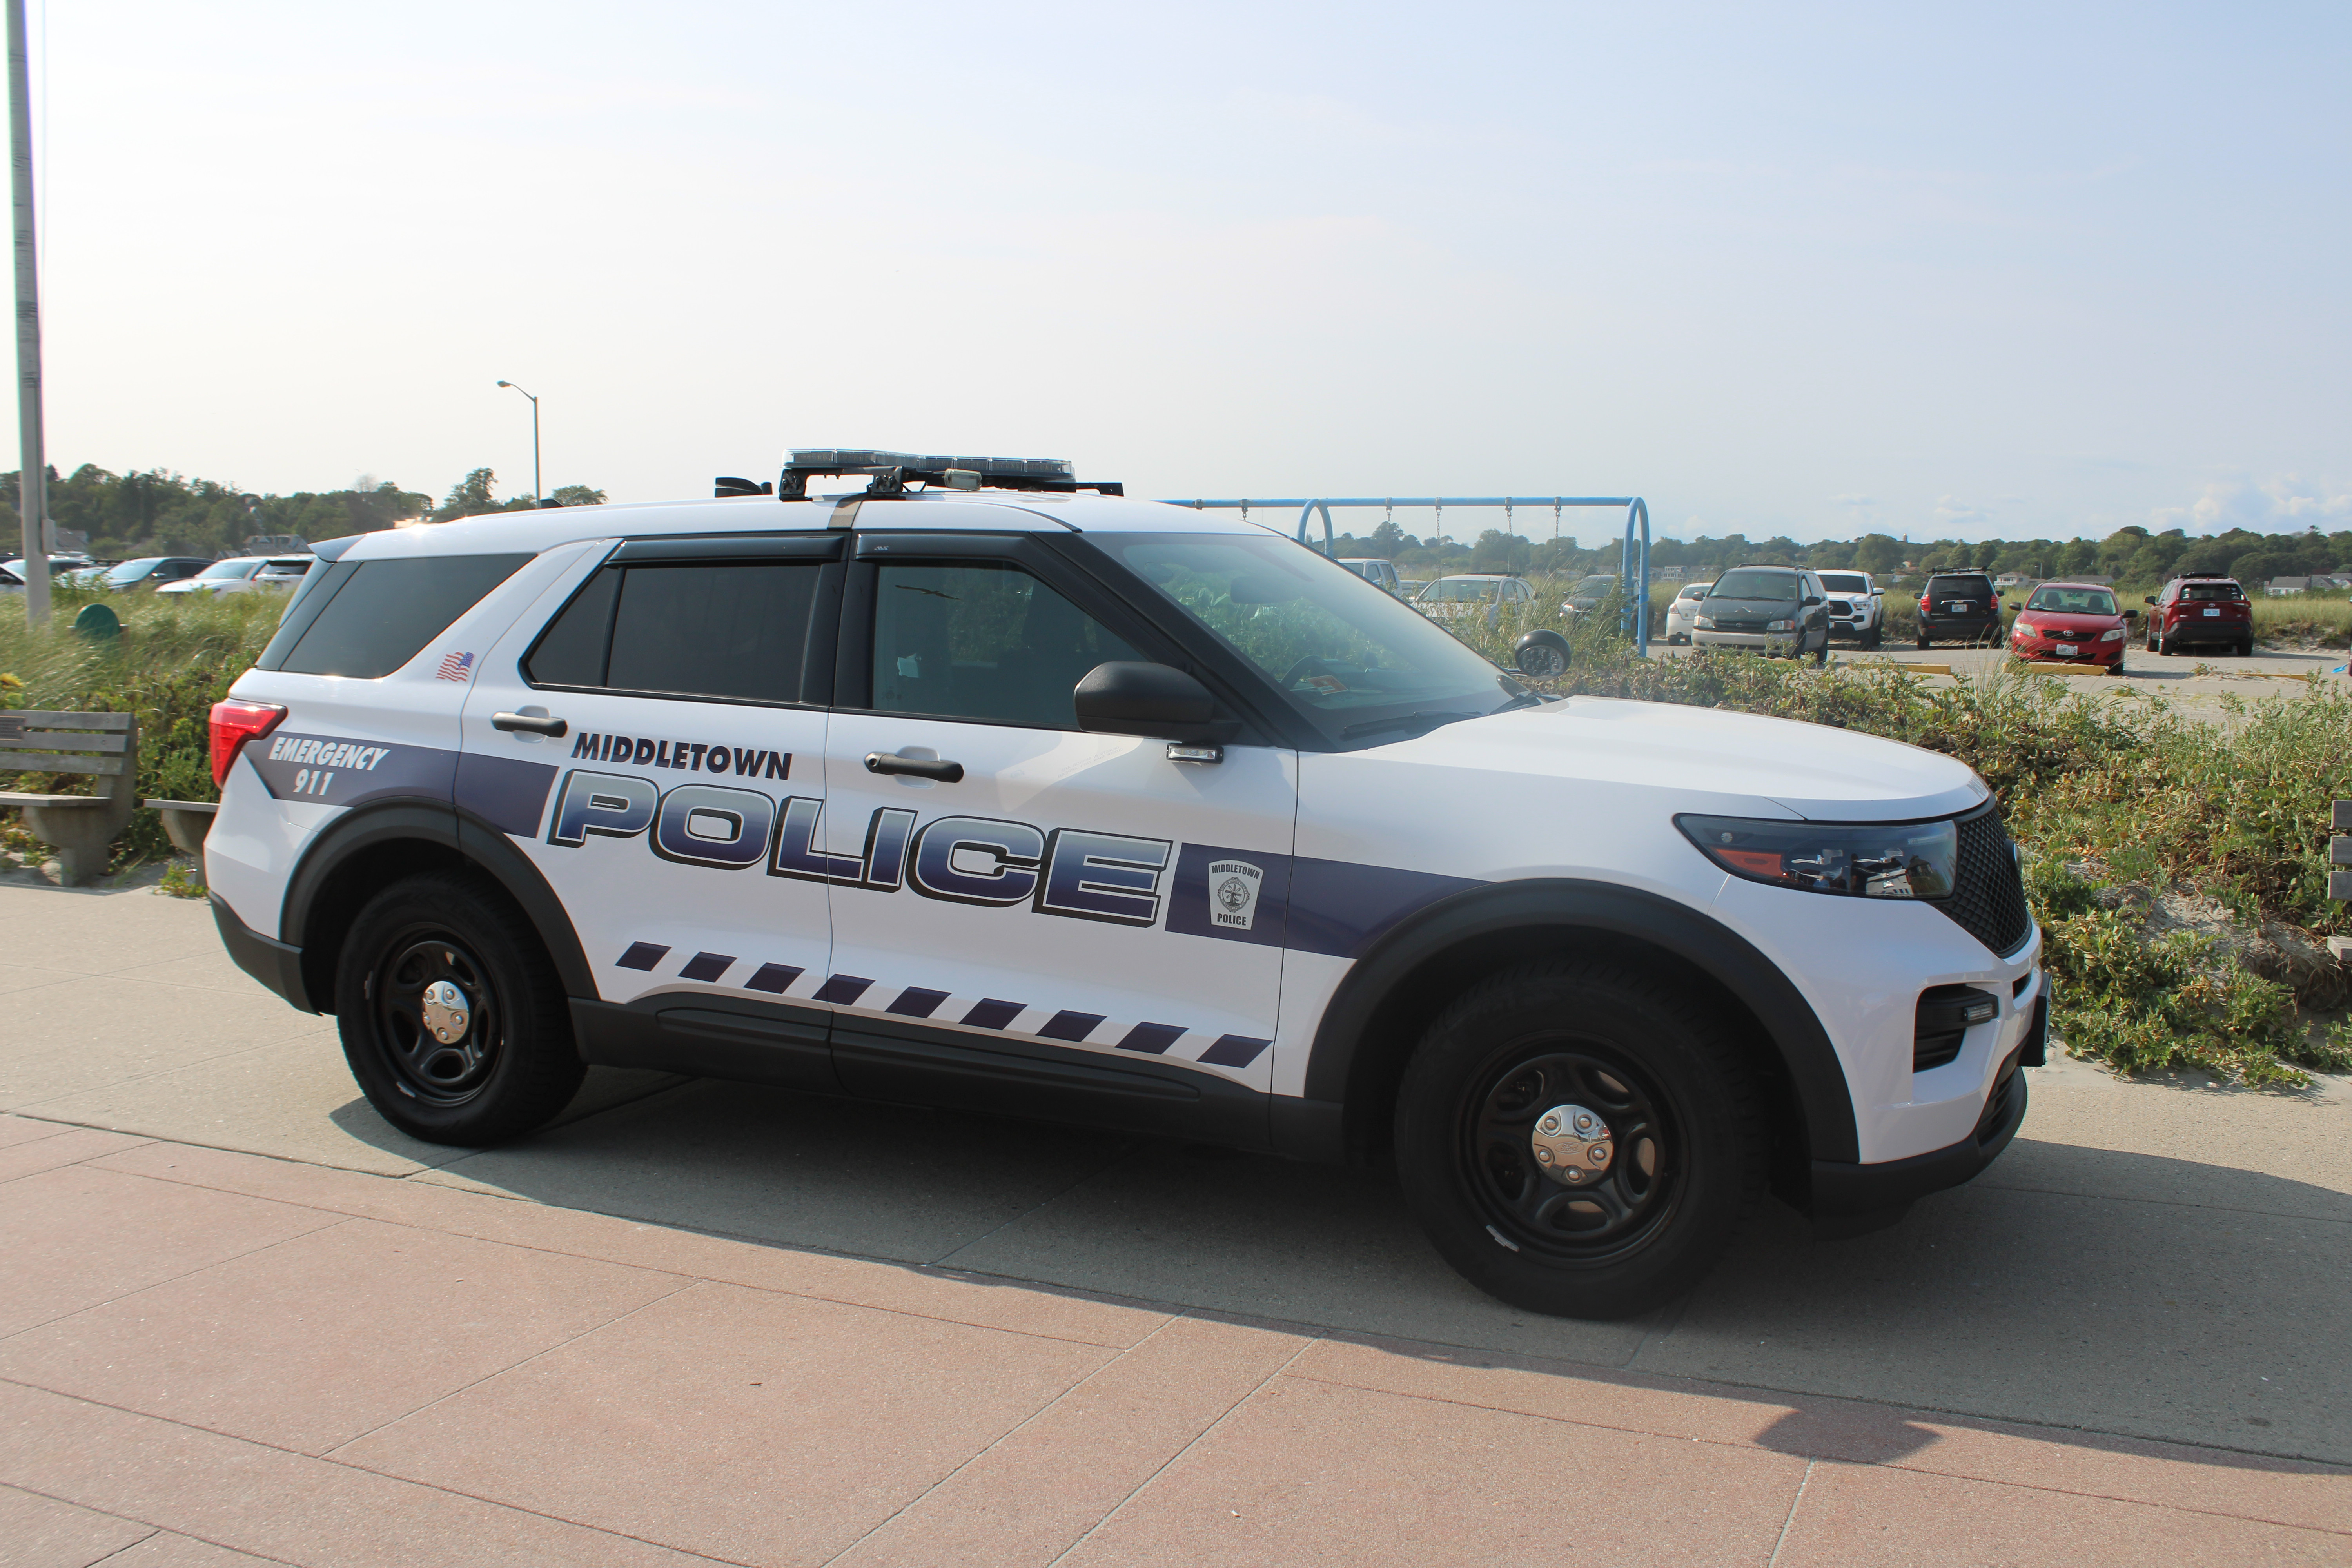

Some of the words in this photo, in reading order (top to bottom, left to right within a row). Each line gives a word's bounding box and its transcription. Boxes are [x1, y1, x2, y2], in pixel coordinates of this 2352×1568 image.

[268, 737, 391, 771] EMERGENCY
[571, 732, 792, 781] MIDDLETOWN
[293, 769, 334, 796] 911
[546, 769, 1174, 929] POLICE
[1211, 864, 1260, 879] MIDDLETOWN
[1217, 913, 1247, 926] POLICE
